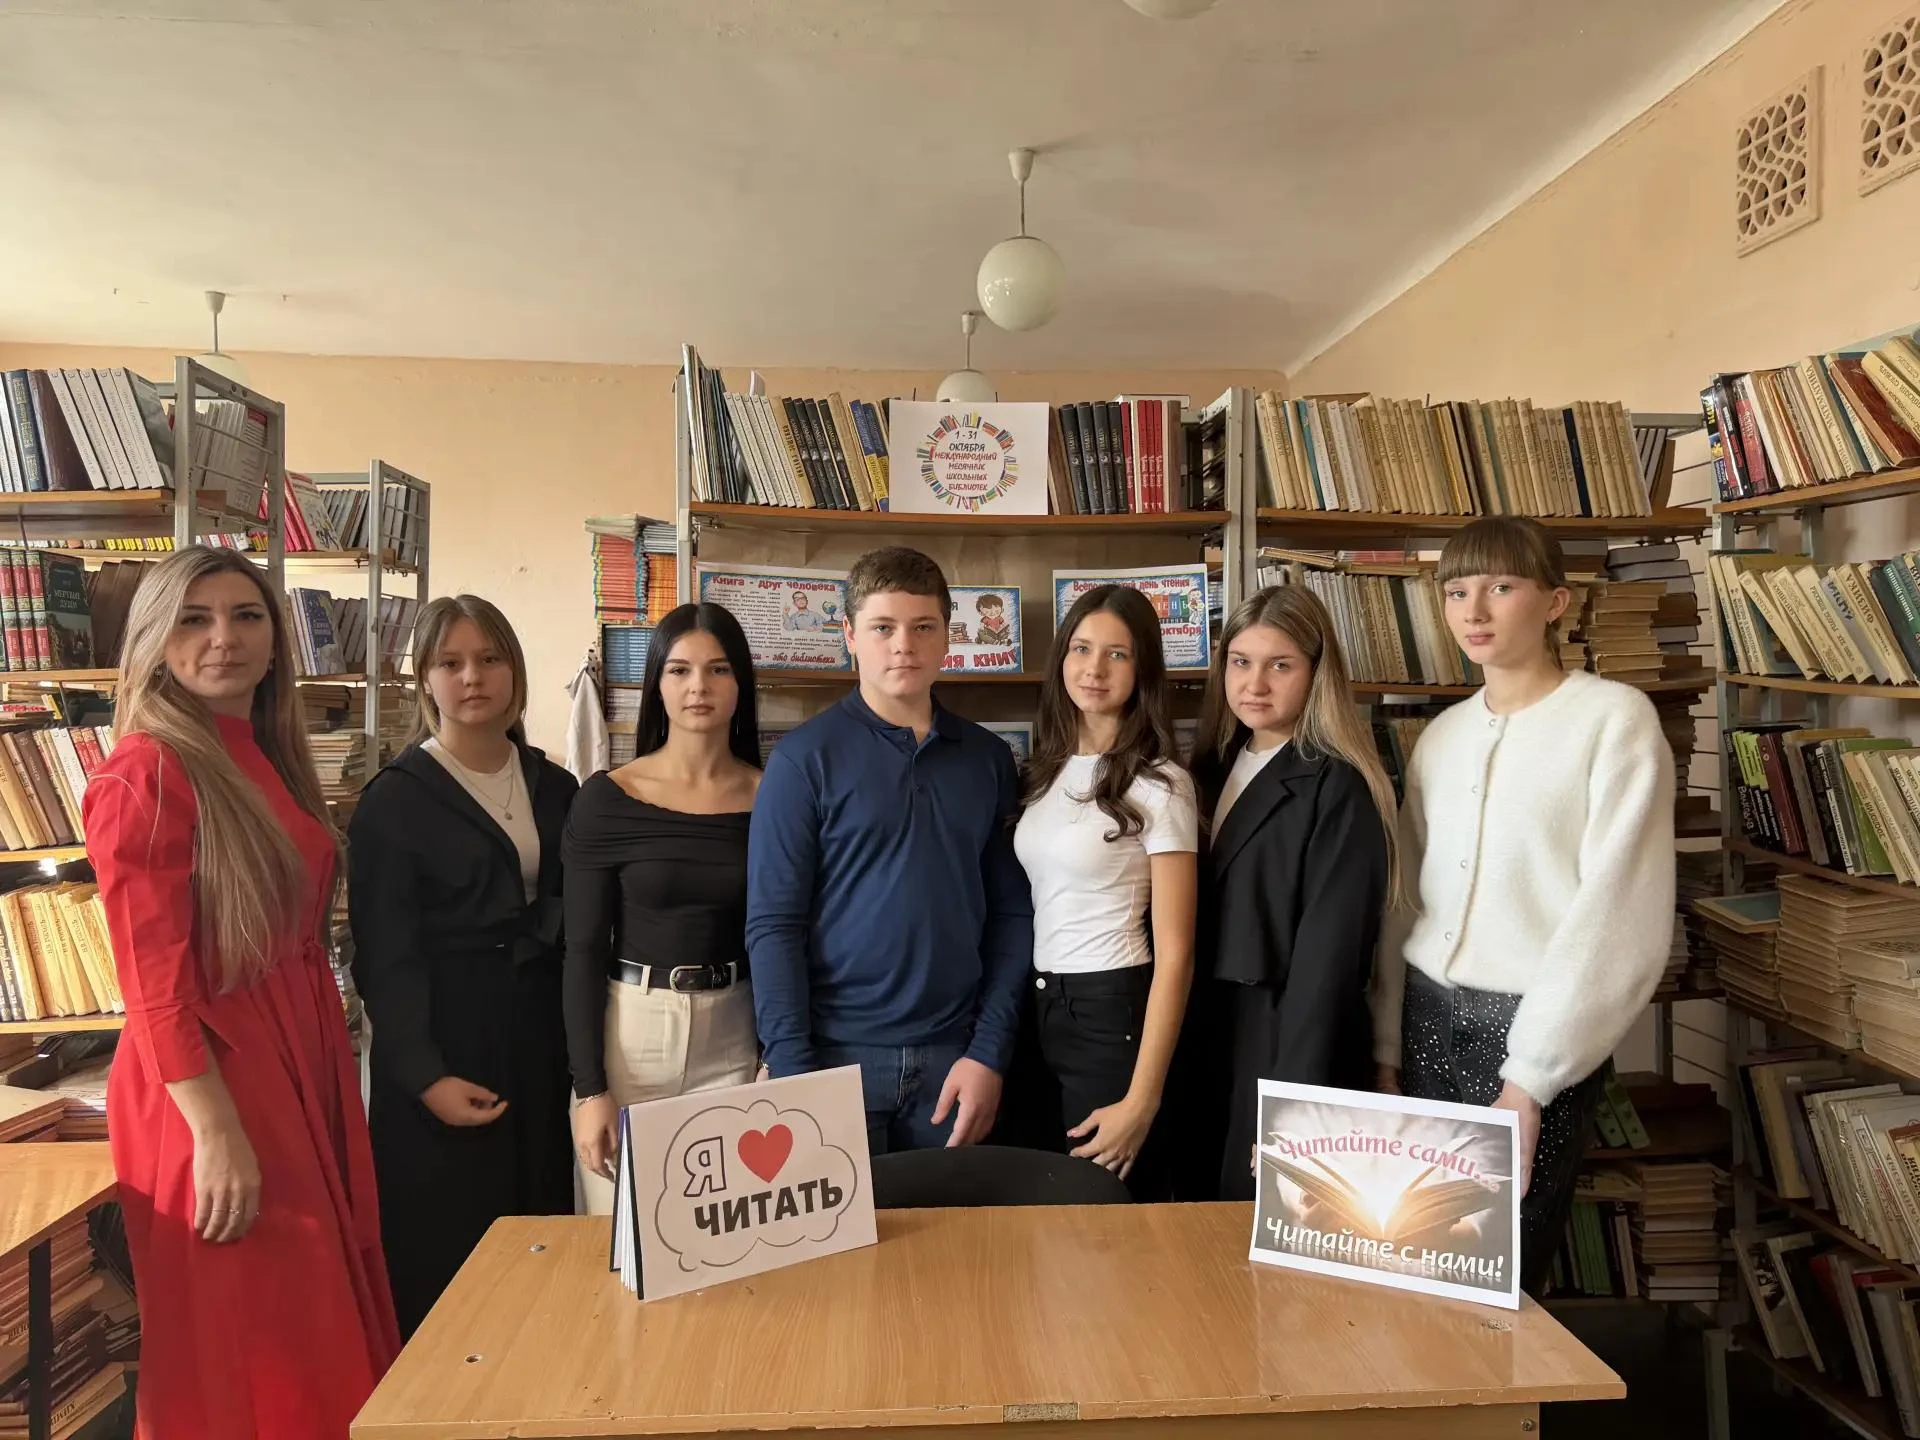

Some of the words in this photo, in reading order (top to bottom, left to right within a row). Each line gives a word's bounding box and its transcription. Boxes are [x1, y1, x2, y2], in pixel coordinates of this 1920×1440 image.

[1805, 364, 1835, 430] МАТЕМАТИКА
[949, 442, 986, 452] ОКТЯБРЯ
[968, 431, 978, 440] 31
[934, 452, 998, 460] МЕЖДУНАРОДНЫЙ
[712, 575, 745, 586] Книга
[758, 579, 783, 592] друг
[786, 581, 836, 592] человека
[1139, 579, 1159, 590] день
[1161, 578, 1190, 588] чтения
[1846, 574, 1874, 624] ФИЗИКА
[772, 652, 788, 662] это
[790, 652, 836, 664] библиотеки
[943, 654, 964, 668] ИЯ
[973, 648, 1017, 668] КНИГ
[1864, 801, 1885, 838] ЗООЛОГИЯ
[1280, 1129, 1402, 1160] Читайте
[683, 1136, 727, 1198] Я
[694, 1178, 843, 1236] ЧИТАТЬ
[1266, 1216, 1394, 1259] Читайте
[1401, 1245, 1414, 1262] с
[1421, 1248, 1504, 1278] нами!
